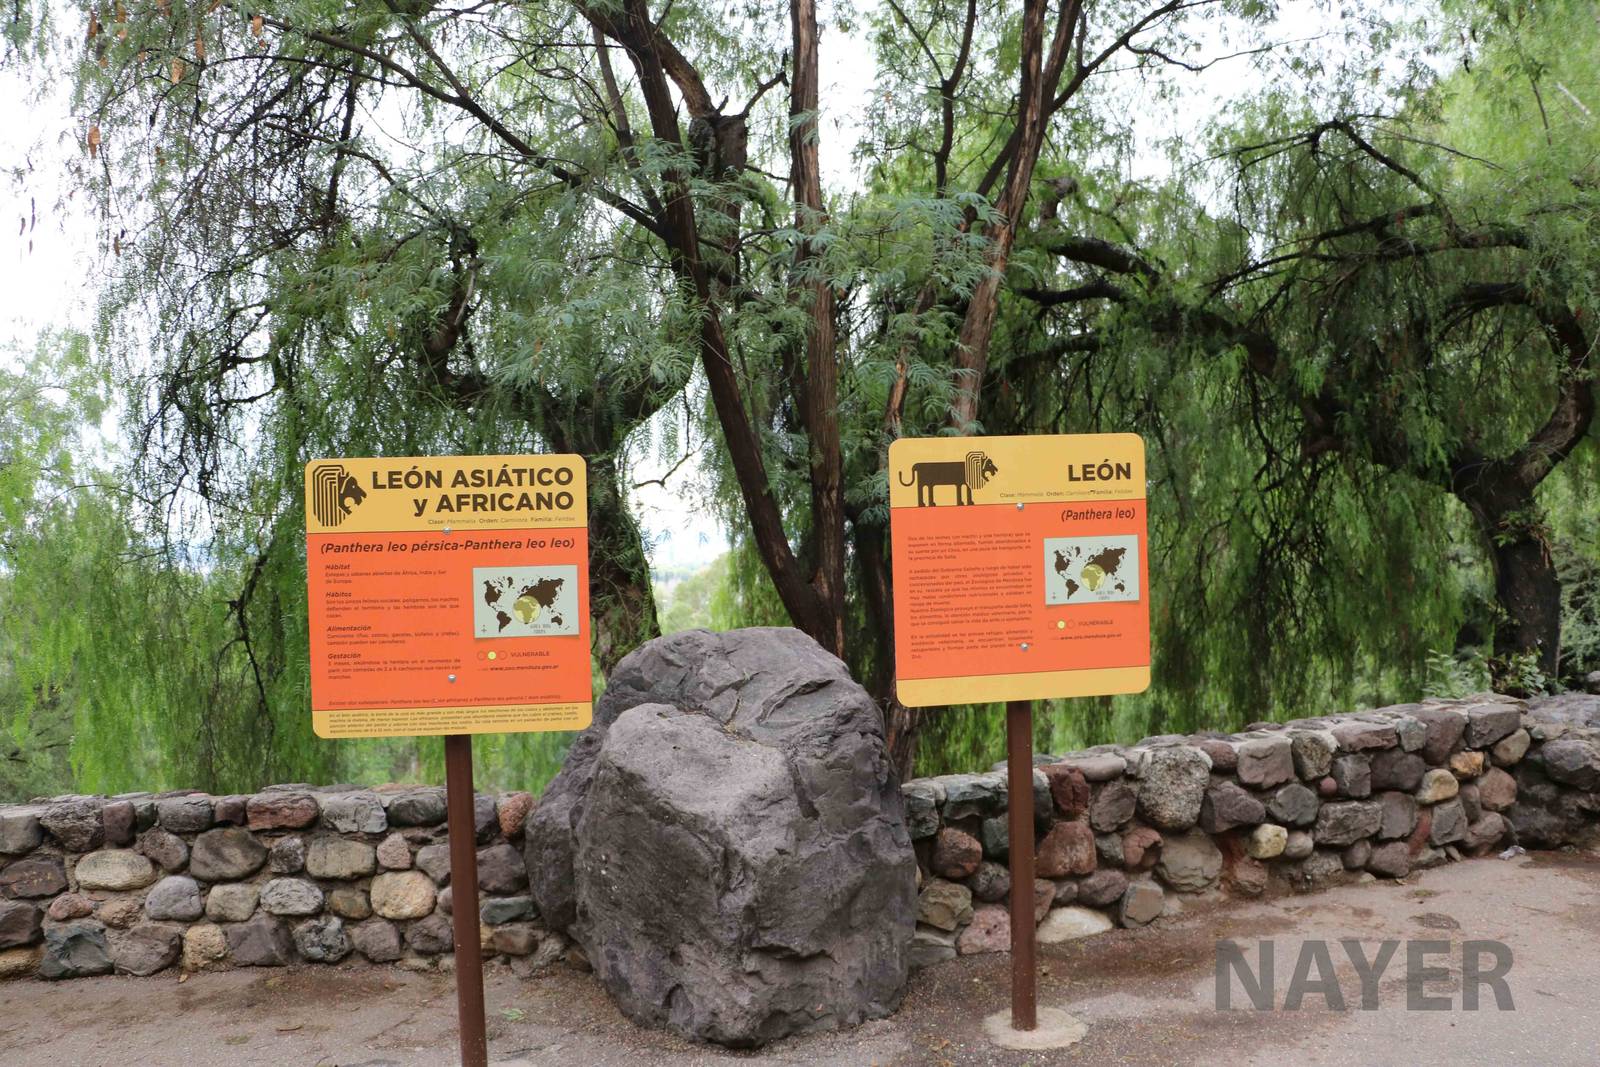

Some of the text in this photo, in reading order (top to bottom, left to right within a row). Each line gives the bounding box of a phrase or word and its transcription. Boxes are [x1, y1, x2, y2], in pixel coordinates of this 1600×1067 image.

[372, 464, 574, 489] LEÓN ASIÁTICO
[1068, 459, 1131, 481] LEÓN
[413, 491, 574, 517] y AFRICANO
[1061, 508, 1136, 522] (Panthera leo)
[320, 537, 575, 554] (Panthera leo pérsica-Panthera leo leo)
